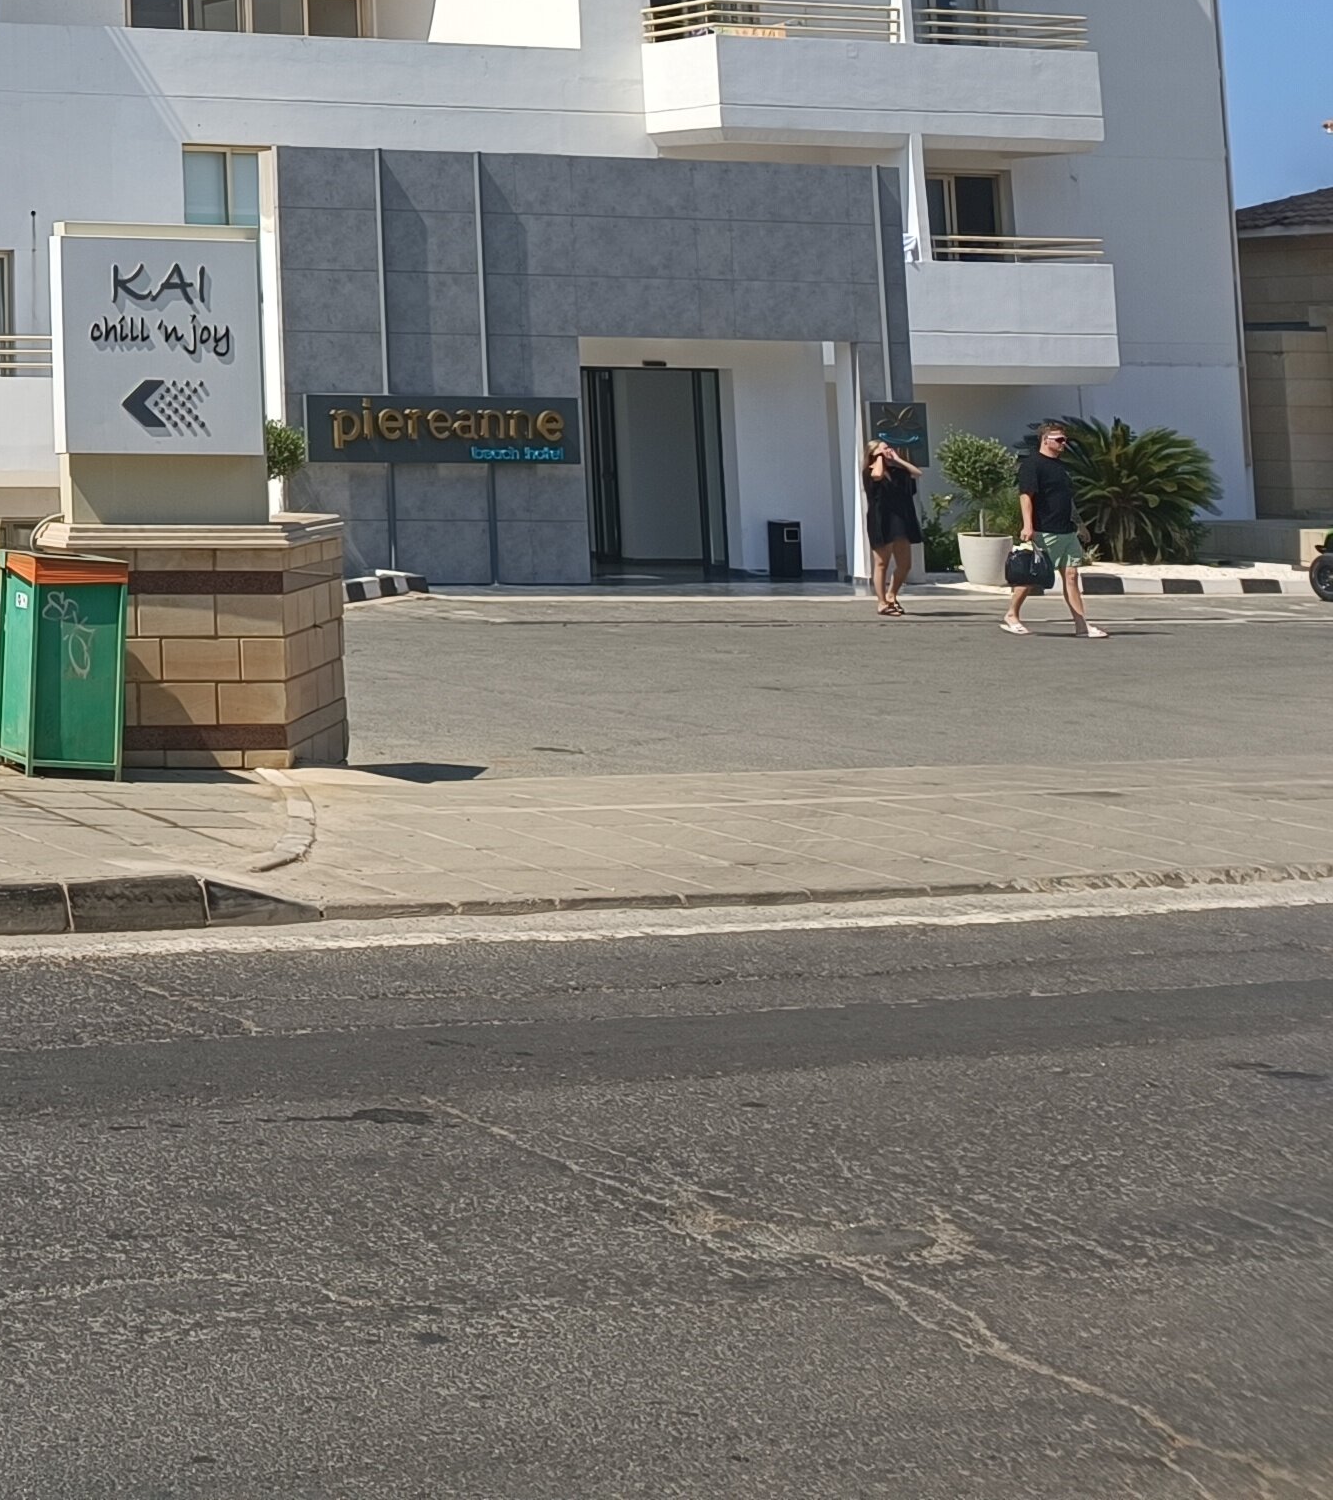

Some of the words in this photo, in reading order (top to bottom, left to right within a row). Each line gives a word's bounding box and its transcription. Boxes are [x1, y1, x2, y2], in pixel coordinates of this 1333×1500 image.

[111, 262, 206, 305] KAI
[90, 315, 150, 342] chill
[329, 397, 566, 450] piereanne
[470, 445, 520, 460] beach
[524, 445, 565, 460] hotel
